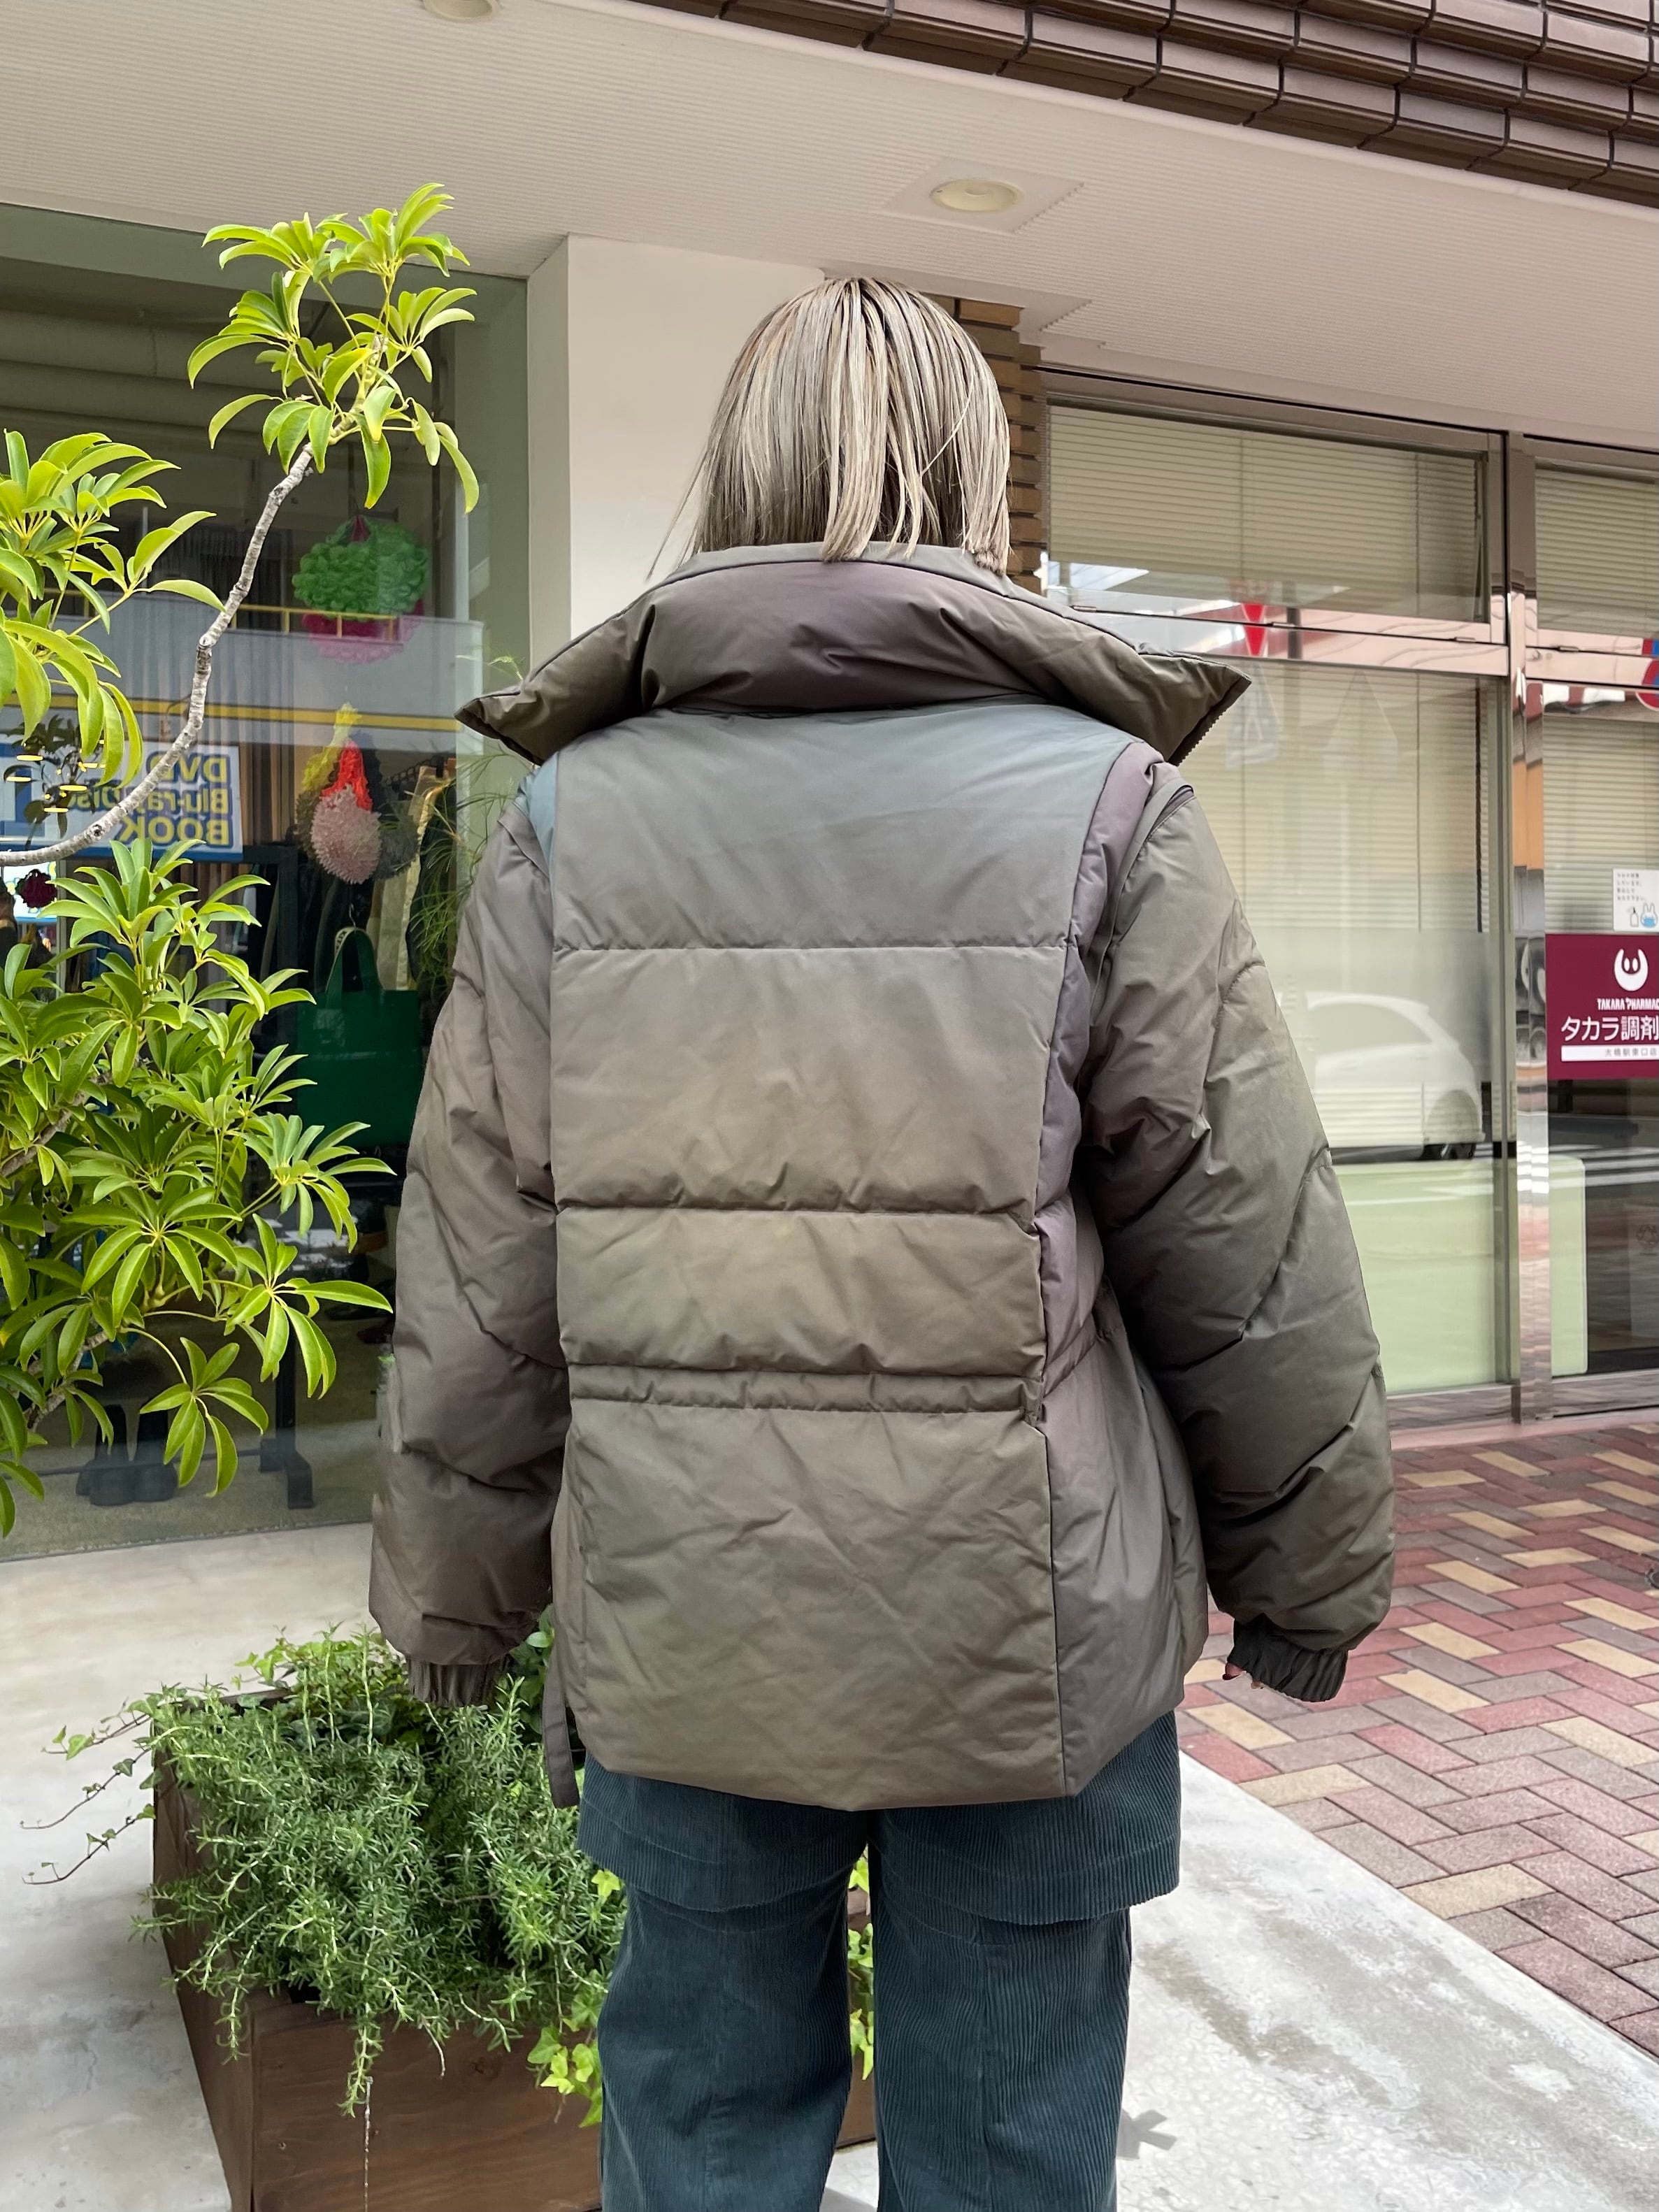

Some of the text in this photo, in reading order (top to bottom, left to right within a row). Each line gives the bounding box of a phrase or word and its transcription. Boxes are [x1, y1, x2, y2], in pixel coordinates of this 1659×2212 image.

[1597, 998, 1625, 1010] TAKARA
[1561, 1015, 1659, 1042] タカラ調剤
